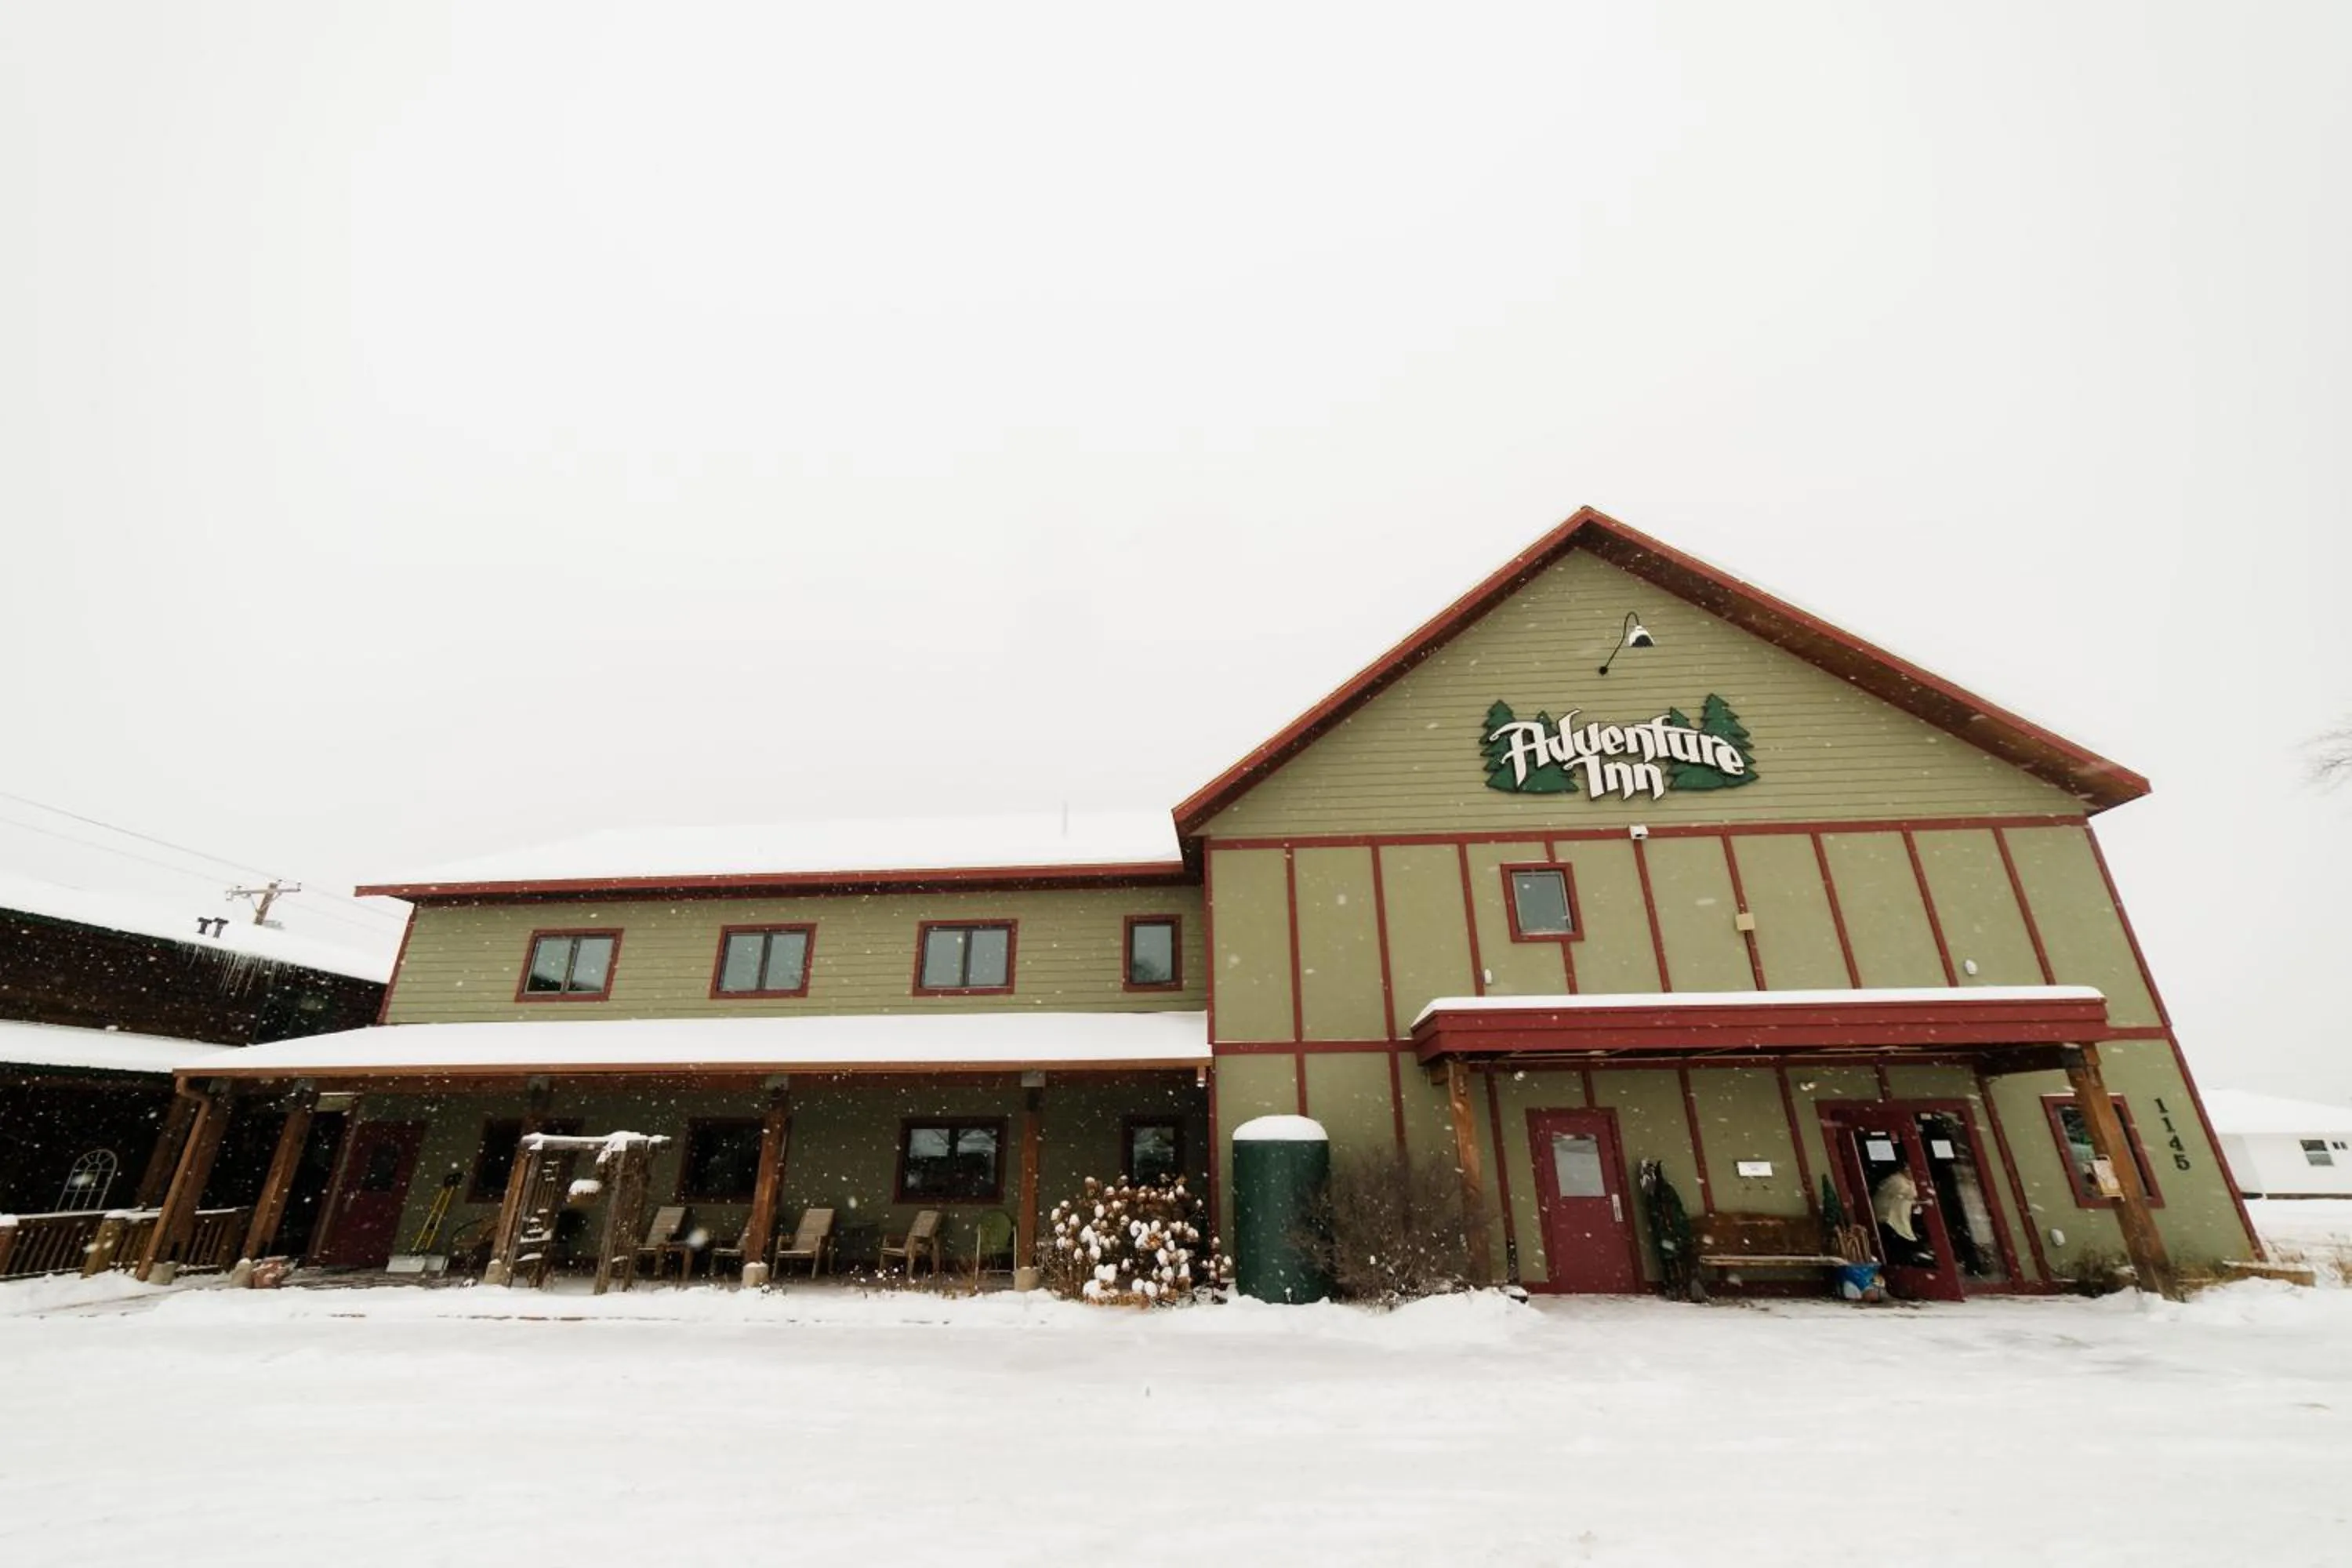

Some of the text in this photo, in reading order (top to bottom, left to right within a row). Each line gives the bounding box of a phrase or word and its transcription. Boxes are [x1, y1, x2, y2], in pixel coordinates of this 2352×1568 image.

[1490, 709, 1744, 785] Adventure
[1563, 755, 1665, 800] Inn
[2154, 1098, 2190, 1171] 1145
